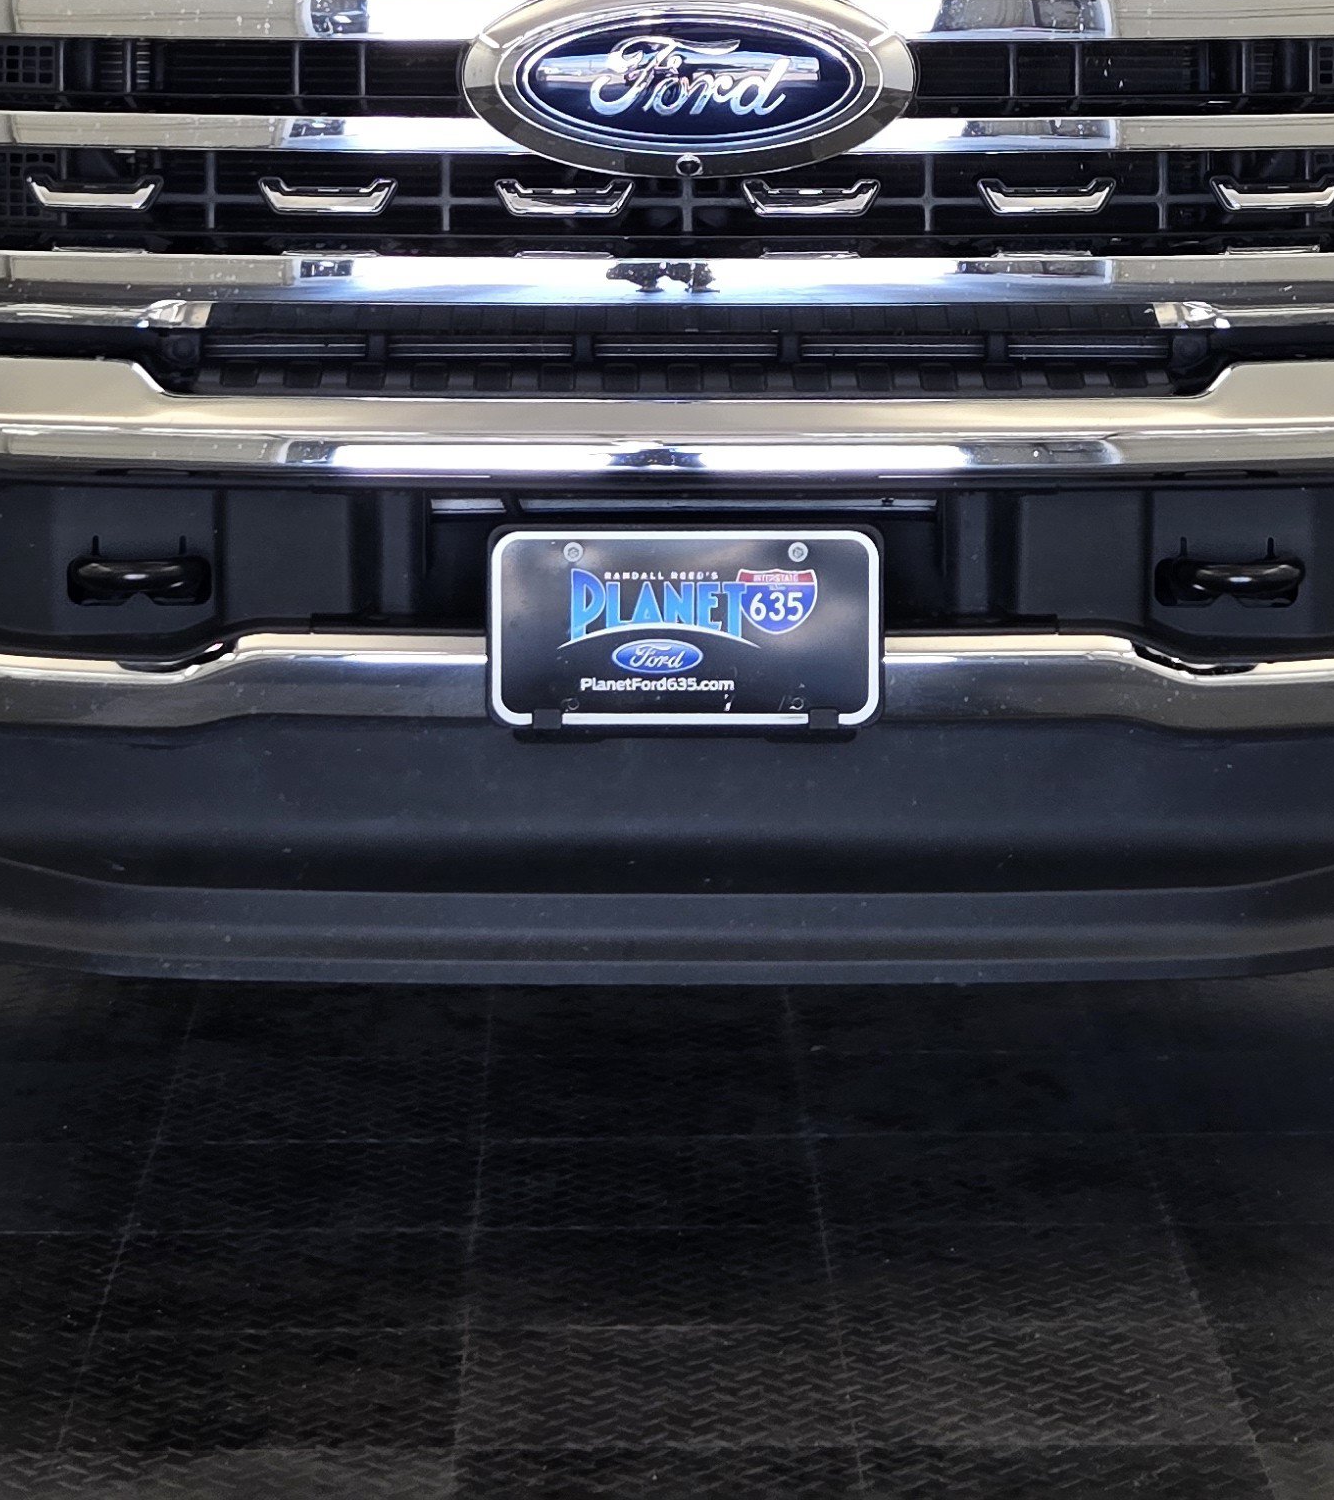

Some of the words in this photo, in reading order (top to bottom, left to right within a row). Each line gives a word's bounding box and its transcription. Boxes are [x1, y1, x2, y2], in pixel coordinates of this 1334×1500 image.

[588, 36, 789, 116] Ford
[604, 571, 664, 580] RANDALL
[570, 568, 747, 641] PLANET
[749, 591, 804, 621] 635
[629, 644, 685, 670] Ford
[580, 676, 735, 692] PlanetFord635.com
